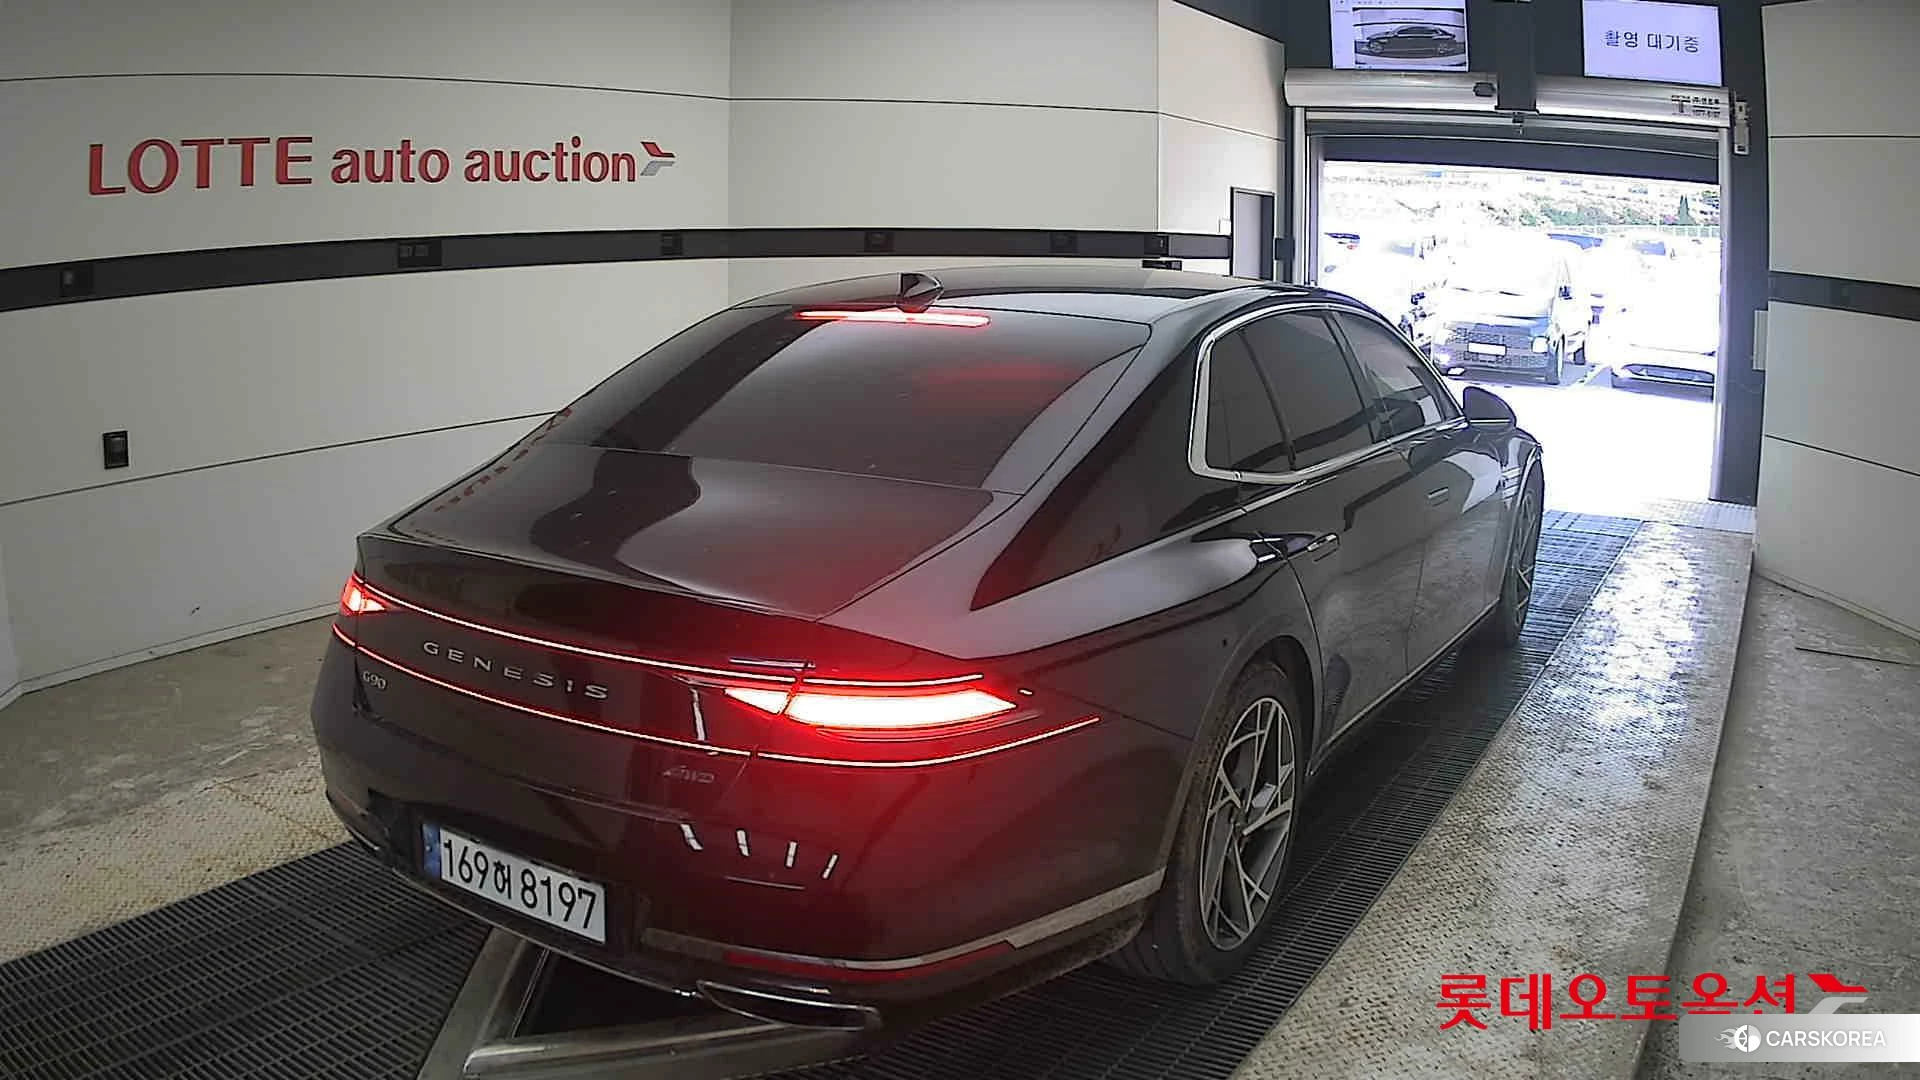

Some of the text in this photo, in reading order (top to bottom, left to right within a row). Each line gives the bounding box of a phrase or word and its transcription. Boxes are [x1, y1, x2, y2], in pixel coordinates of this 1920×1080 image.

[1647, 33, 1699, 53] 대기중
[89, 135, 637, 195] LOTTE auto auction
[362, 671, 387, 689] G90
[423, 641, 609, 700] GENESIS
[520, 868, 597, 929] 8197
